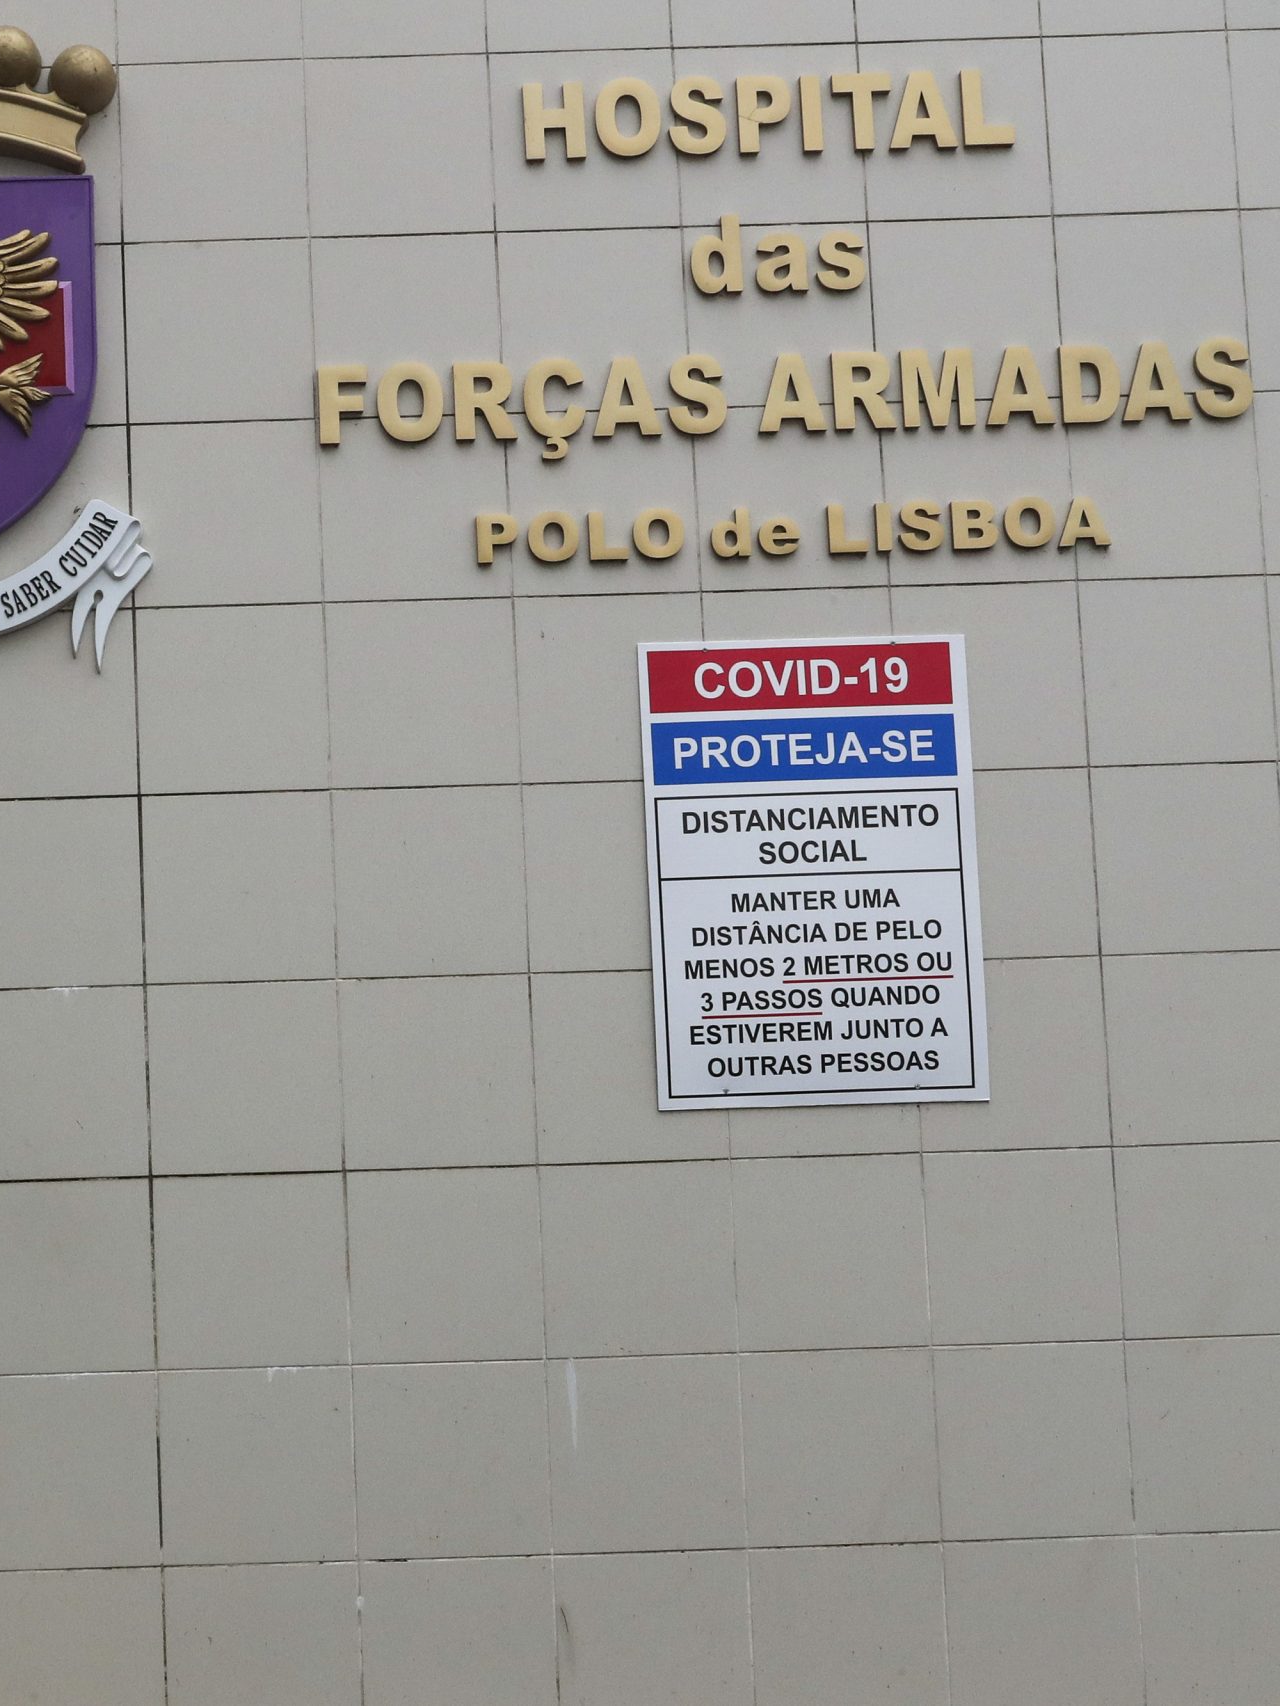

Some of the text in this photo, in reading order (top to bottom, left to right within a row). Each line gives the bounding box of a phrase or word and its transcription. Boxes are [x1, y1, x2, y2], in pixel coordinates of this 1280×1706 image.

[521, 69, 1016, 163] HOSPITAL
[690, 213, 866, 296] das
[318, 336, 1255, 460] FORÇAS ARMADAS
[475, 496, 1111, 565] POLO de LISBOA
[0, 572, 62, 618] SABER
[58, 511, 118, 577] CUIDAR
[693, 656, 909, 699] COVID-19
[673, 729, 935, 770] PROTEJA-SE
[682, 804, 939, 834] DISTANCIAMENTO
[759, 840, 867, 865] SOCIAL
[731, 888, 900, 913] MANTER UMA
[691, 919, 942, 947] DISTÂNCIA DE PELO
[684, 952, 952, 980] MENOS 2 METROS OU
[700, 985, 940, 1012] 3 PASSOS QUANDO
[690, 1017, 948, 1046] ESTIVEREM JUNTO A
[707, 1050, 940, 1078] OUTRAS PESSOAS
